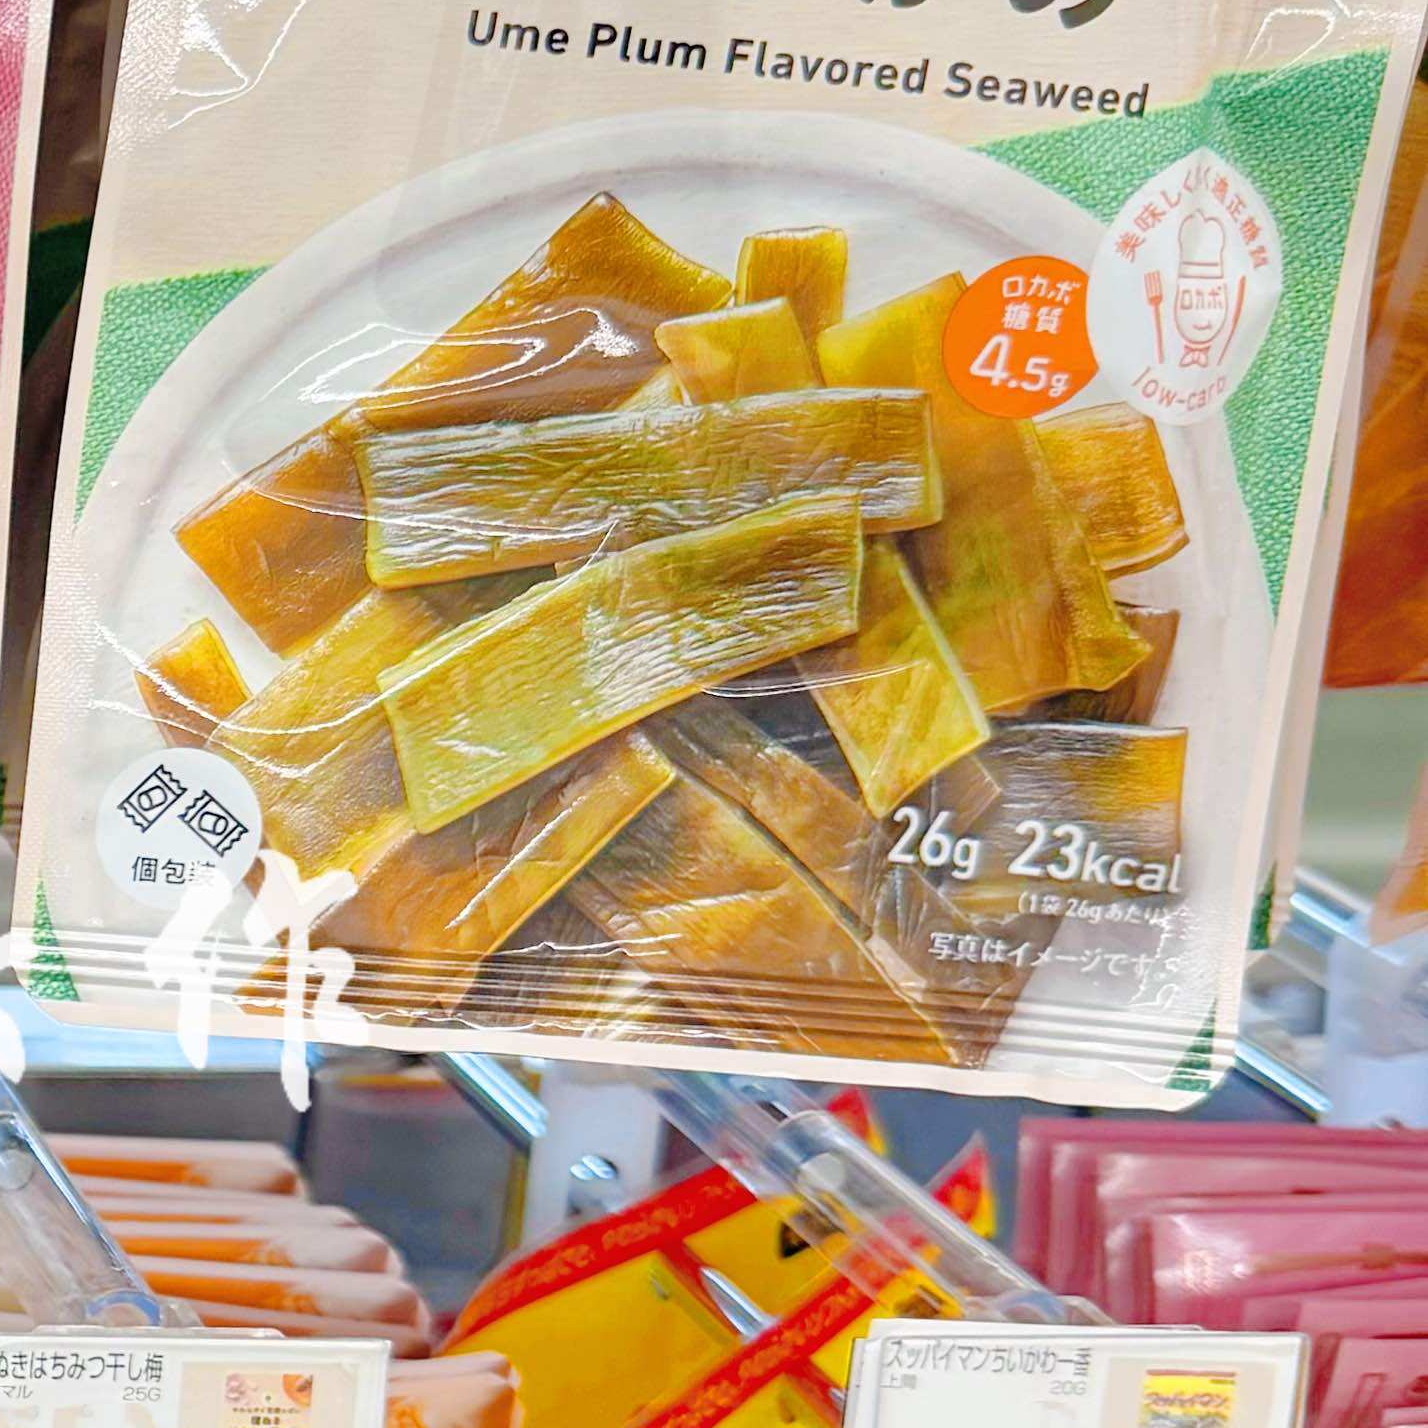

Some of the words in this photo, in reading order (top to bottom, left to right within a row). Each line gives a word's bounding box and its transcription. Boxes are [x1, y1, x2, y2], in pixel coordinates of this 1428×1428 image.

[467, 10, 568, 61] Ume
[586, 21, 709, 73] Plum
[727, 38, 929, 98] Flavored
[945, 62, 1150, 121] Seaweed
[1001, 273, 1081, 305] ロカボ
[1178, 285, 1224, 311] ロカボ
[1003, 305, 1062, 335] 糖質
[969, 333, 1070, 399] 4.5g
[1131, 367, 1228, 413] low-carb
[886, 804, 982, 880] 26g
[1007, 819, 1181, 894] 23kcal
[122, 1386, 162, 1402] 25G
